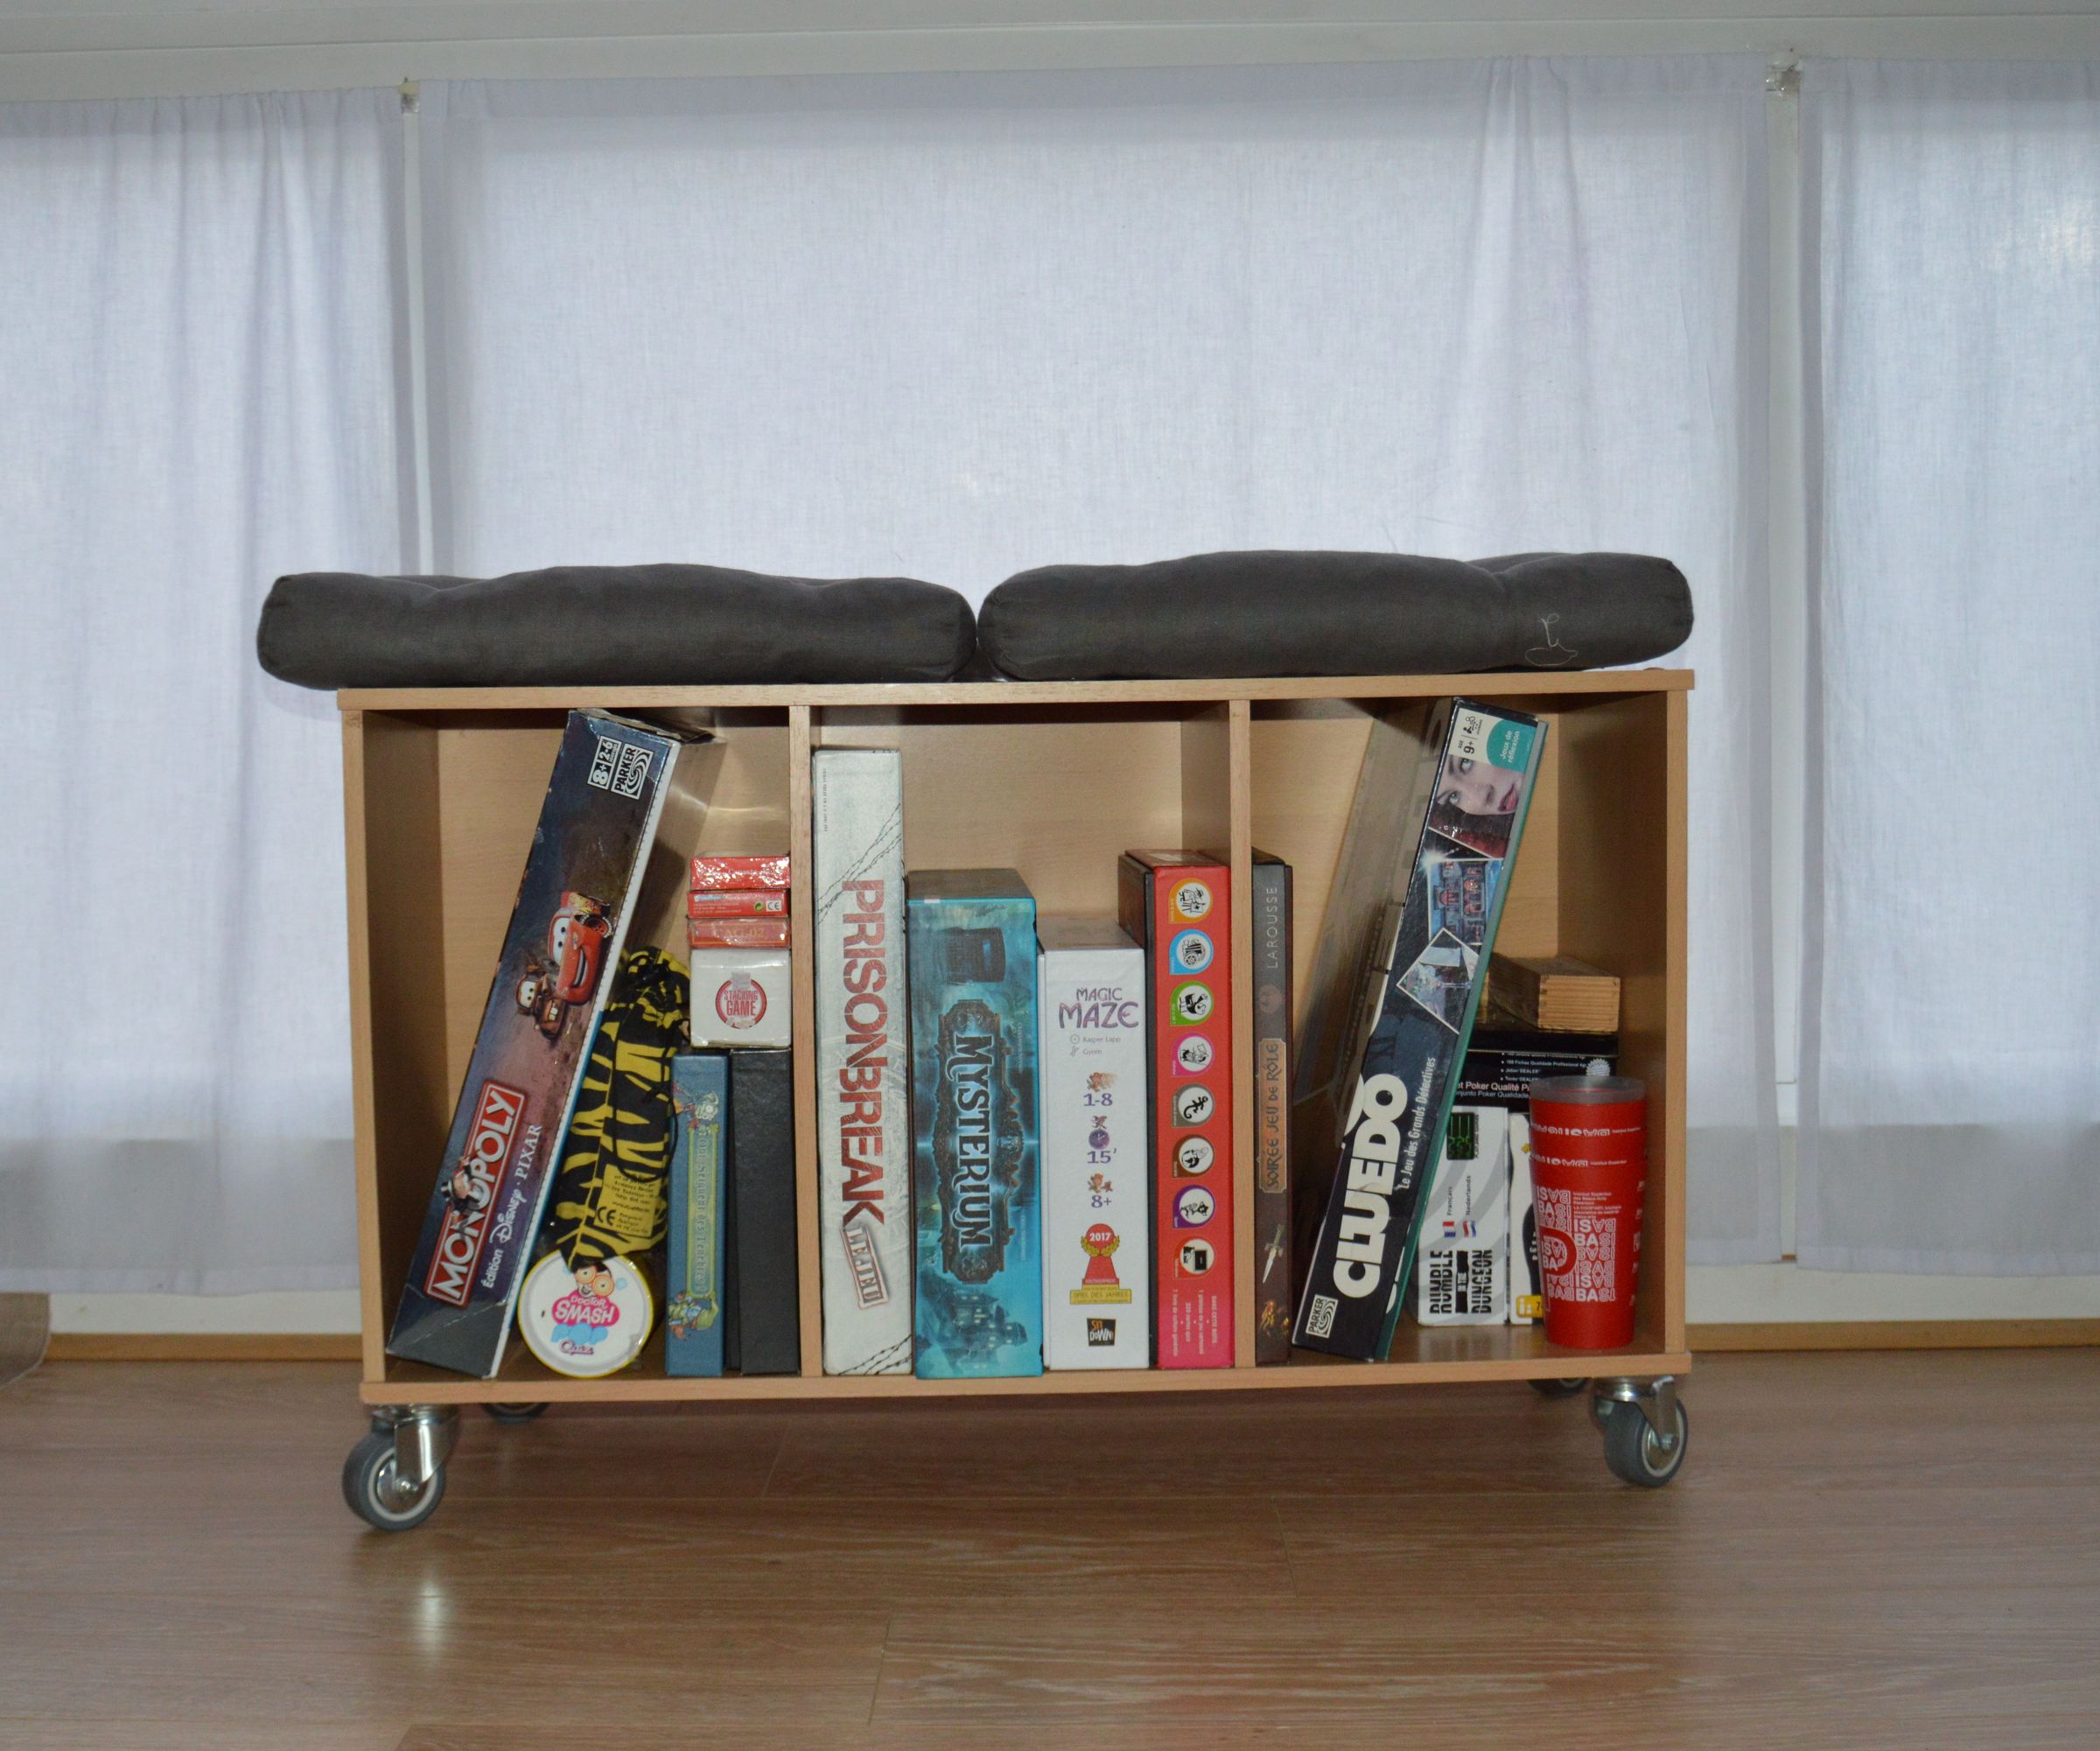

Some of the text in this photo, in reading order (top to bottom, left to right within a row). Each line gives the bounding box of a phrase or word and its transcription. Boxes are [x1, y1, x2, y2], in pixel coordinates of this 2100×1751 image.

[1500, 731, 1513, 760] Jeux de
[614, 747, 637, 792] PARKER
[1266, 886, 1278, 969] LAROUSSE
[724, 990, 759, 1001] STACKING
[726, 1000, 756, 1016] GAME
[1075, 987, 1124, 1001] MAGIC
[1058, 1001, 1139, 1029] MAZE
[1263, 1043, 1283, 1082] RÔLE
[1082, 1093, 1114, 1107] 1-8
[1466, 1081, 1489, 1090] Poker
[1491, 1082, 1520, 1092] Qualité
[1266, 1106, 1279, 1133] JEU
[1399, 1056, 1436, 1190] Le Jeu des Grands Détectives
[514, 1124, 543, 1180] PIXAR
[946, 1033, 994, 1252] MYSTERIUM
[1263, 1138, 1283, 1188] SOIRÉE
[433, 1090, 517, 1299] MONOPOLY
[1091, 1194, 1112, 1208] 8+
[1332, 1073, 1409, 1299] CLUEDO
[1089, 1232, 1111, 1242] 2017
[845, 1227, 881, 1300] LE JEU
[1471, 1249, 1493, 1314] DUNGEON
[555, 1299, 616, 1324] SMASH
[570, 1295, 610, 1309] DOCTOR
[1308, 1298, 1325, 1333] PARKER
